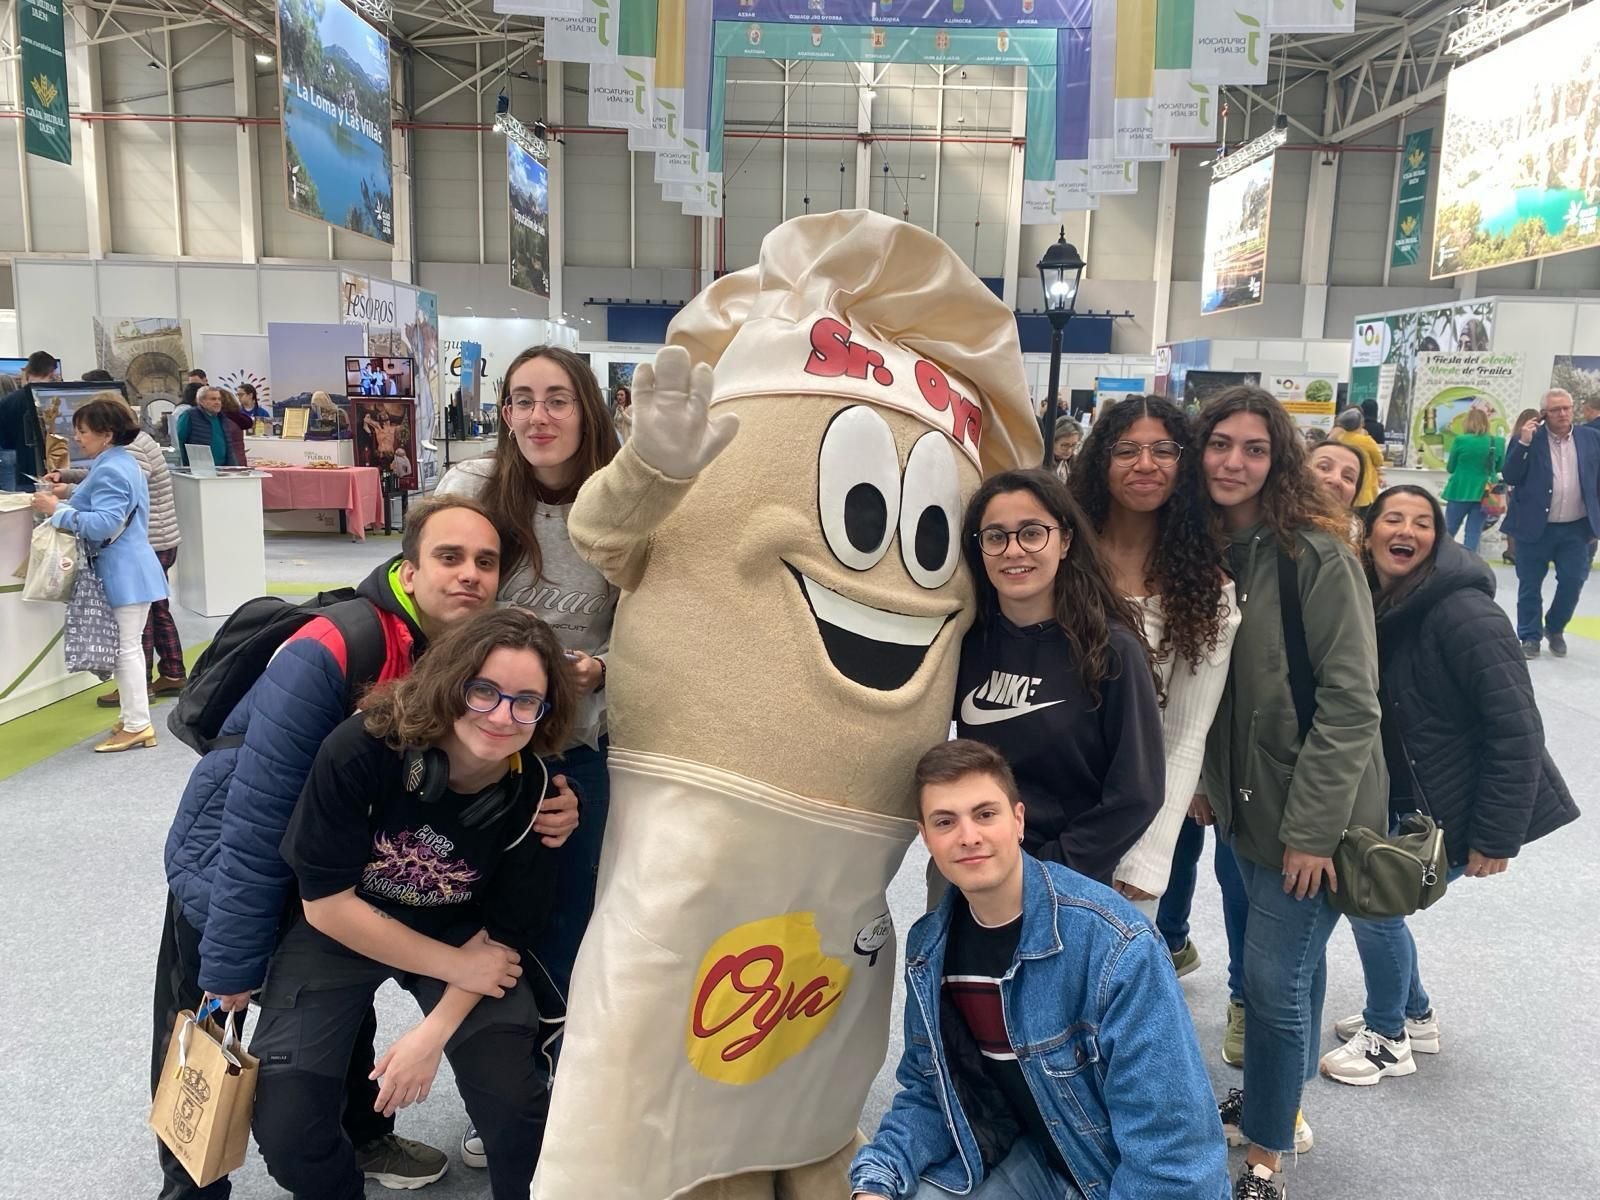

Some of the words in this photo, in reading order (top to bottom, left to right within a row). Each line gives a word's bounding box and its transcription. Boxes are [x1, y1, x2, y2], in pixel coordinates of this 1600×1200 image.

[296, 76, 309, 102] La
[310, 86, 337, 118] Loma
[338, 106, 344, 127] y
[345, 108, 360, 132] Las
[360, 115, 382, 144] Villas
[804, 317, 894, 386] Sr.
[1462, 366, 1475, 375] de
[1464, 355, 1480, 364] del
[976, 670, 1043, 708] NIKE
[414, 824, 454, 857] 2022
[692, 944, 842, 1062] Oya
